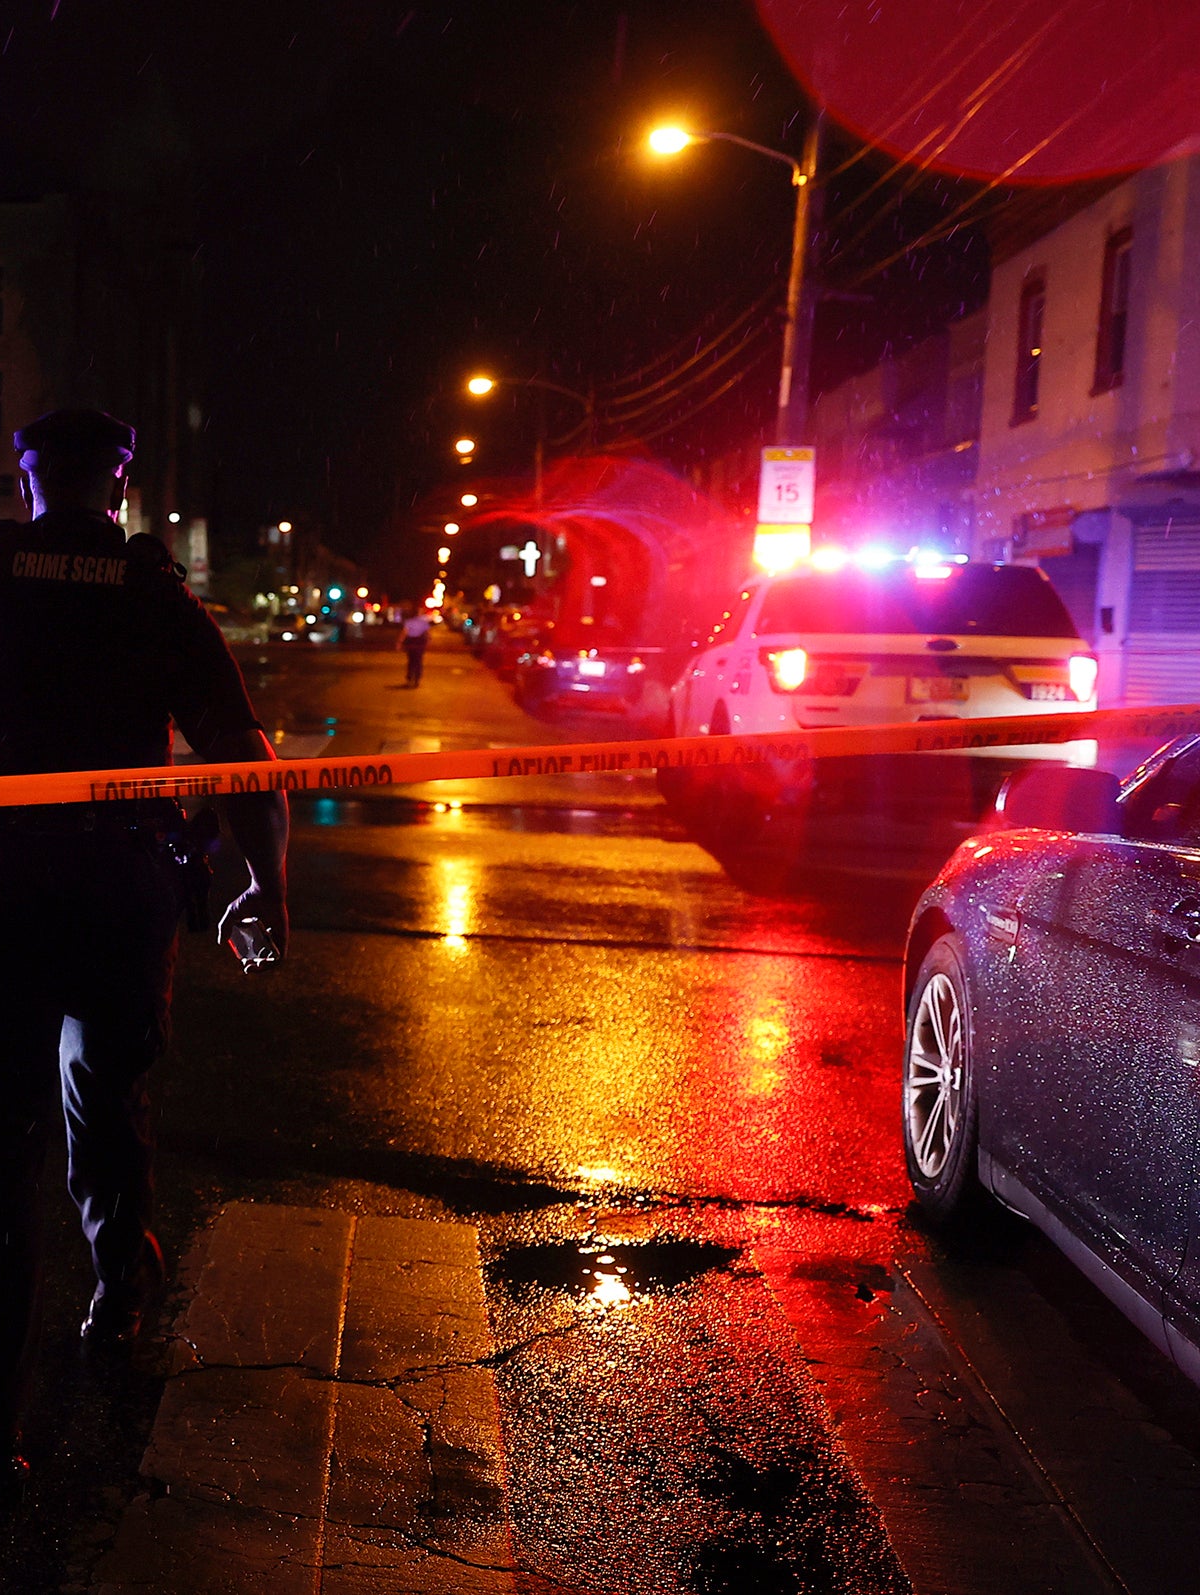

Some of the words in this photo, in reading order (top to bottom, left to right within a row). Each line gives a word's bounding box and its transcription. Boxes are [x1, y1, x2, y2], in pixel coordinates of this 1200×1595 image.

[776, 484, 799, 503] 15
[12, 551, 69, 581] CRIME
[71, 555, 127, 586] SCENE
